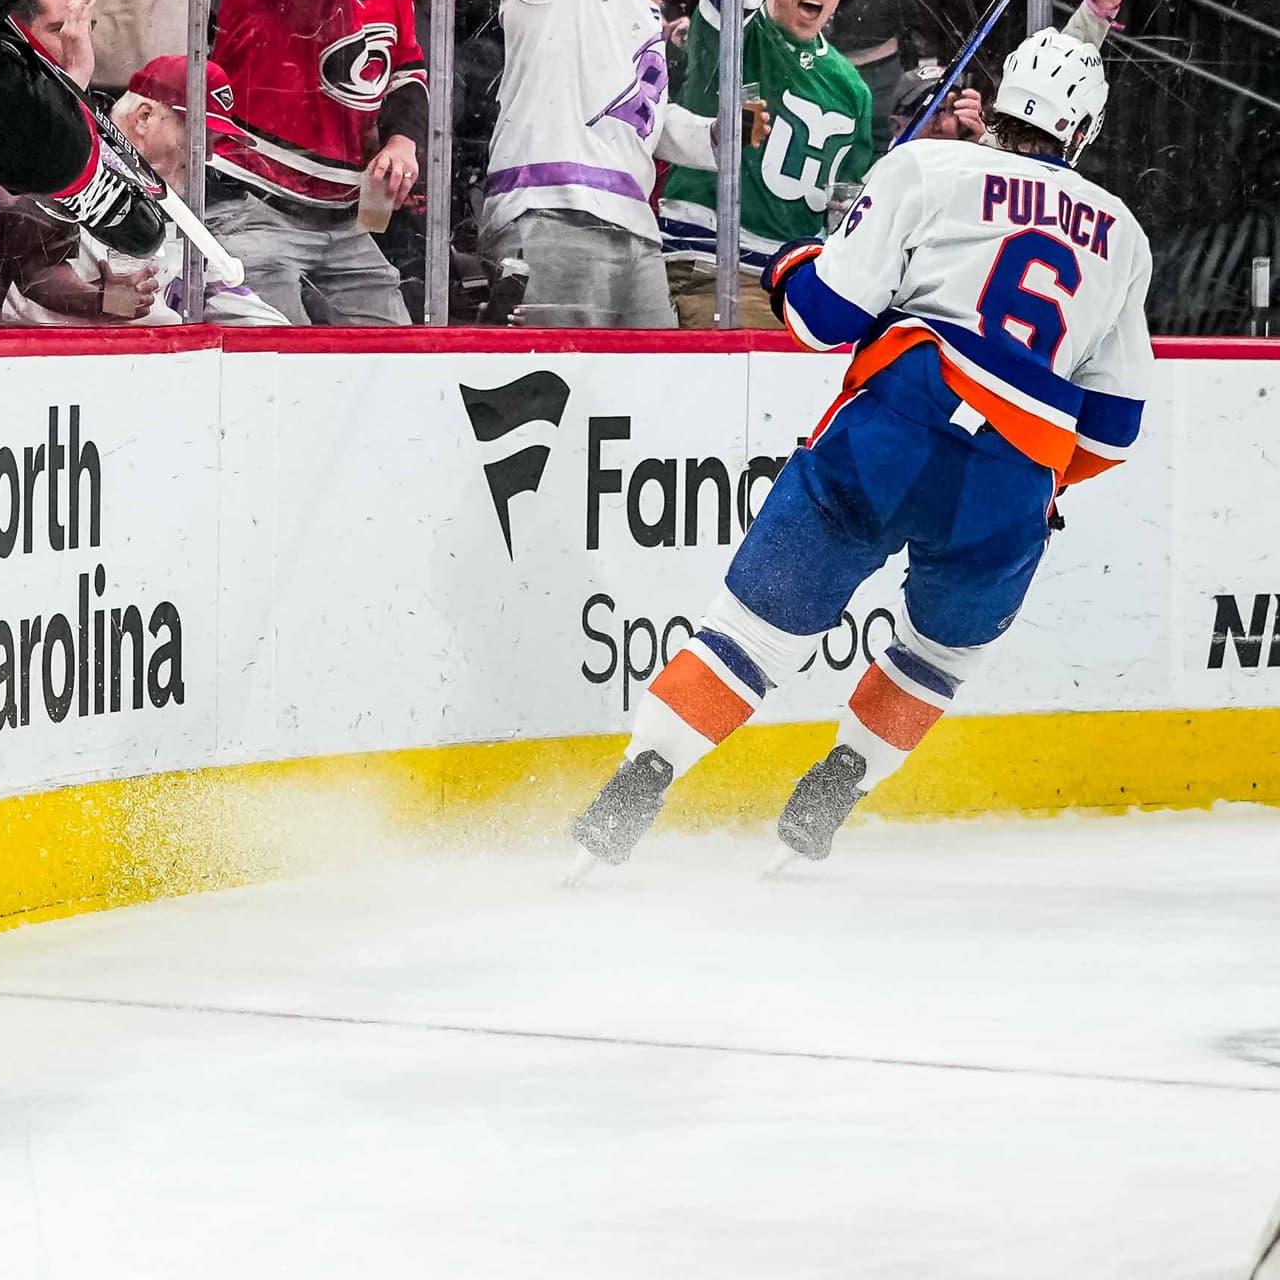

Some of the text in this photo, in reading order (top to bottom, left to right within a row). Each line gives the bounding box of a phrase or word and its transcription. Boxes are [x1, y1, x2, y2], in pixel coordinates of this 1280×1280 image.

[1023, 98, 1037, 117] 6
[844, 194, 873, 239] 6
[982, 173, 1117, 262] PULOCK
[976, 227, 1083, 375] 6
